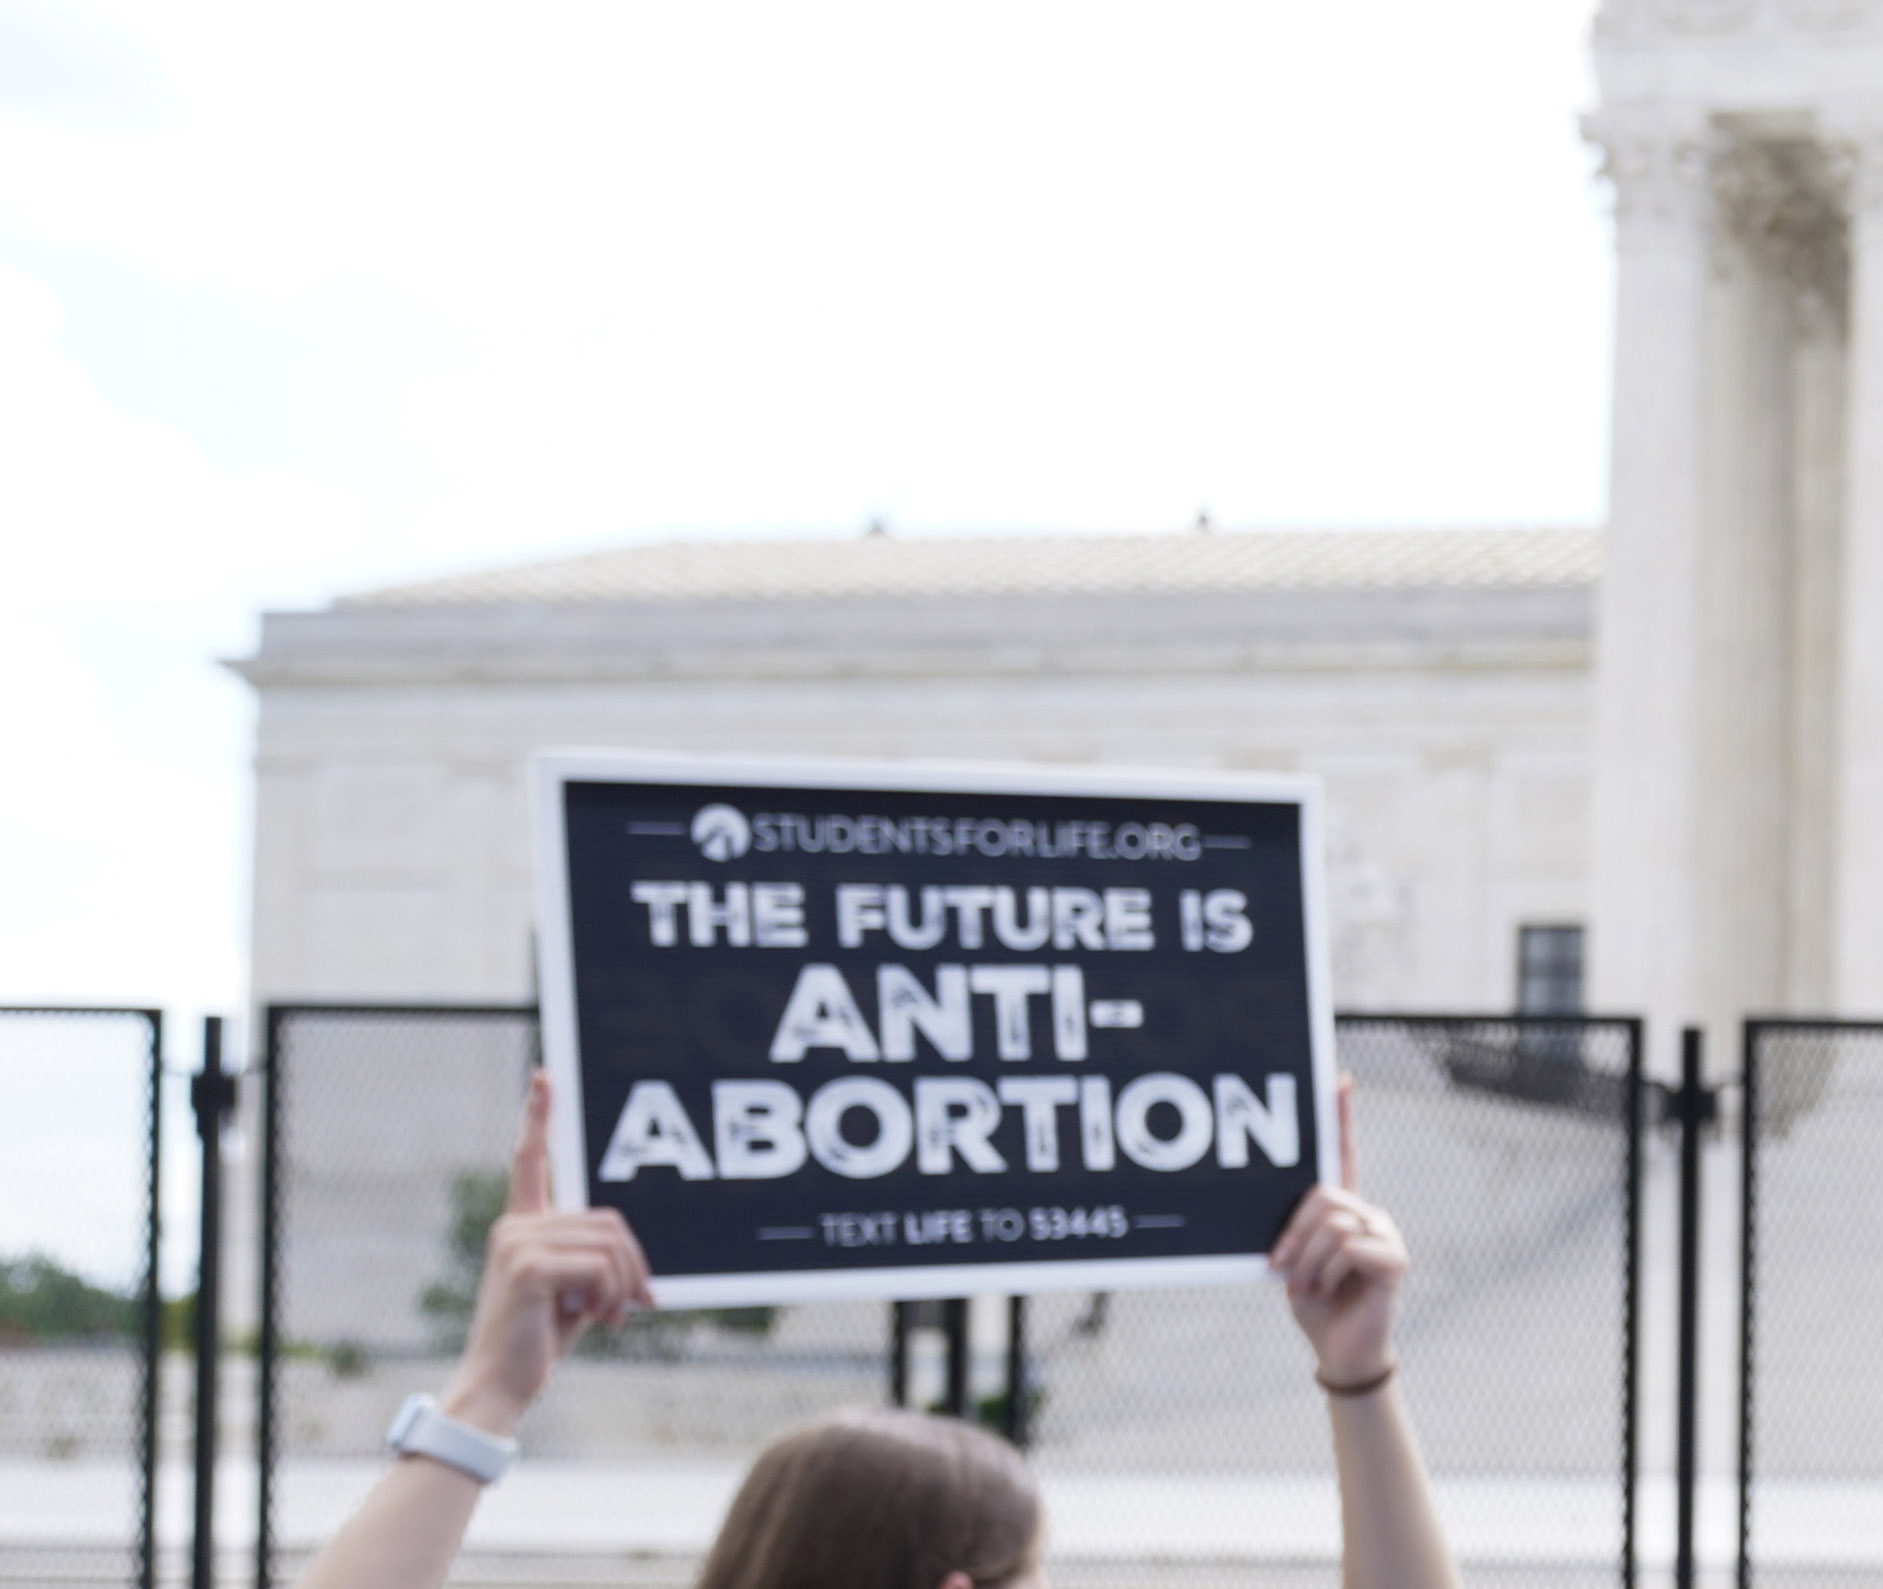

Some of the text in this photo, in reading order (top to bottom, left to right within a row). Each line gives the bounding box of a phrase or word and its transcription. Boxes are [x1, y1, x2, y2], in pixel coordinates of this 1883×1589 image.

[753, 813, 1201, 861] STUDENTSFORLIFE.ORG
[631, 880, 1254, 953] THE FUTURE IS
[769, 963, 1144, 1064] ANTI-
[599, 1072, 1300, 1183] ABORTION
[820, 1213, 897, 1246] TEXT
[904, 1209, 973, 1244] LIFE
[979, 1207, 1024, 1241] TO
